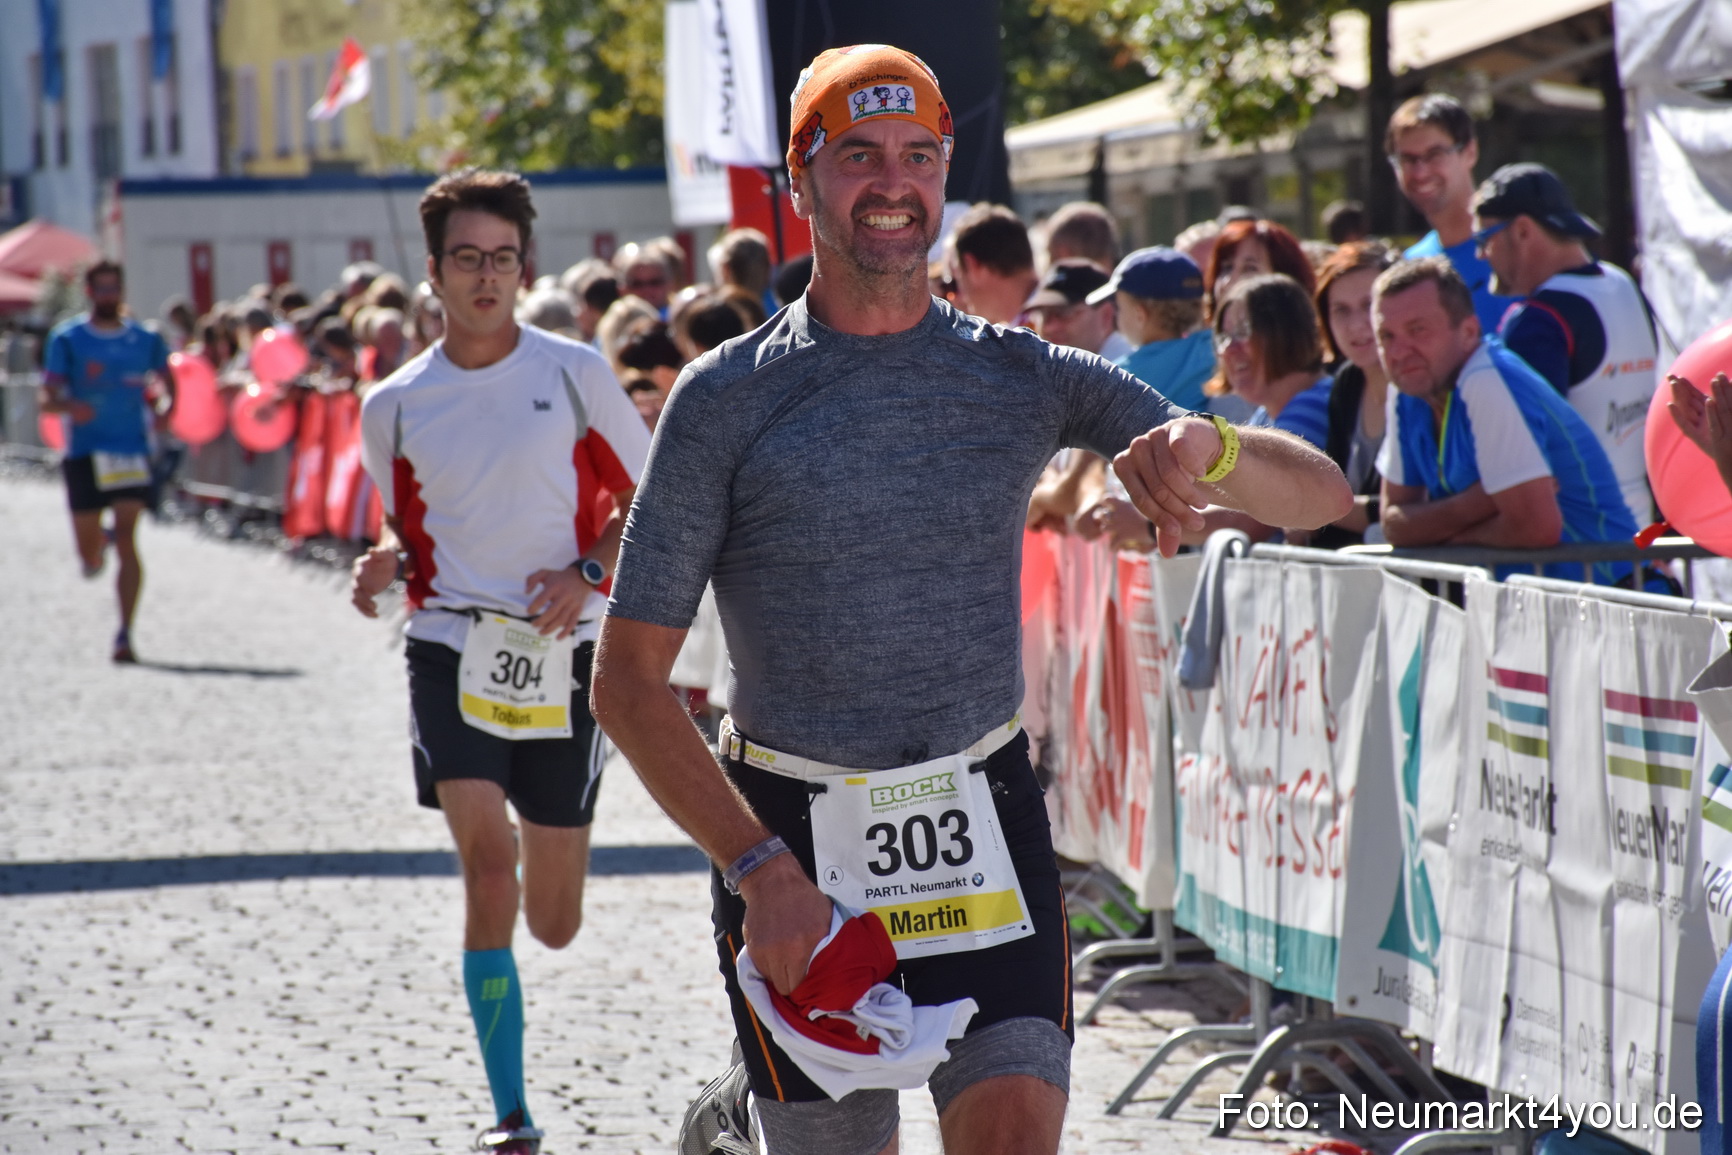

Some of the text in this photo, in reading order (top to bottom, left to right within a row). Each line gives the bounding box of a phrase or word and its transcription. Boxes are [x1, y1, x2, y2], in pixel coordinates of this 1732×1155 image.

[491, 650, 545, 691] 304
[492, 705, 533, 727] Tobias
[870, 772, 957, 807] BOCK
[872, 805, 899, 814] inspired
[909, 798, 929, 807] smart
[929, 793, 959, 802] concepts
[865, 809, 974, 877] 303
[829, 871, 838, 882] A
[865, 876, 968, 899] PARTL Neumarkt
[889, 905, 968, 936] Martin
